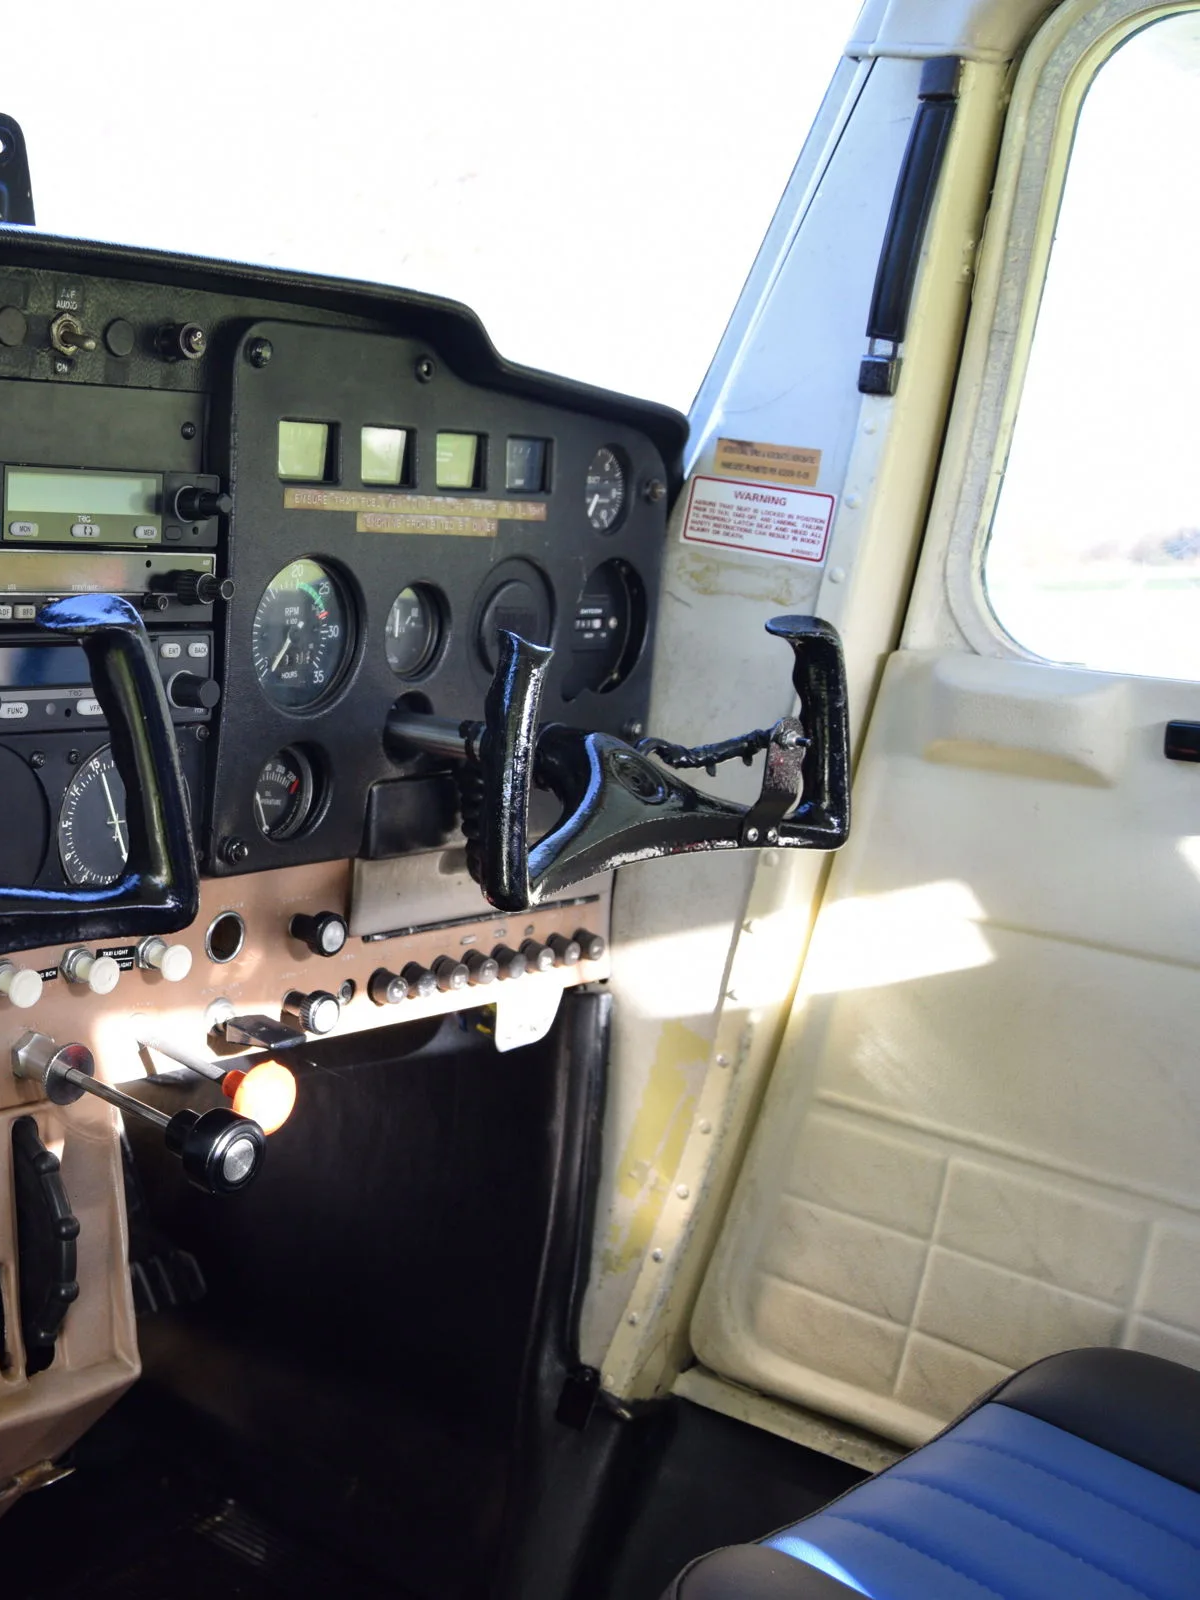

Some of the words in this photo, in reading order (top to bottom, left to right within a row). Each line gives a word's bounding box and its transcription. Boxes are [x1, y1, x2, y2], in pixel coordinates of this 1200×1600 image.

[733, 490, 787, 507] WARNING
[291, 565, 304, 578] 20
[318, 582, 330, 595] 25
[285, 607, 300, 617] RPM
[328, 625, 339, 638] 30
[281, 671, 298, 679] HOURS
[313, 670, 325, 684] 35
[7, 707, 24, 715] FUNC
[89, 758, 101, 772] 15
[45, 970, 57, 978] BCN
